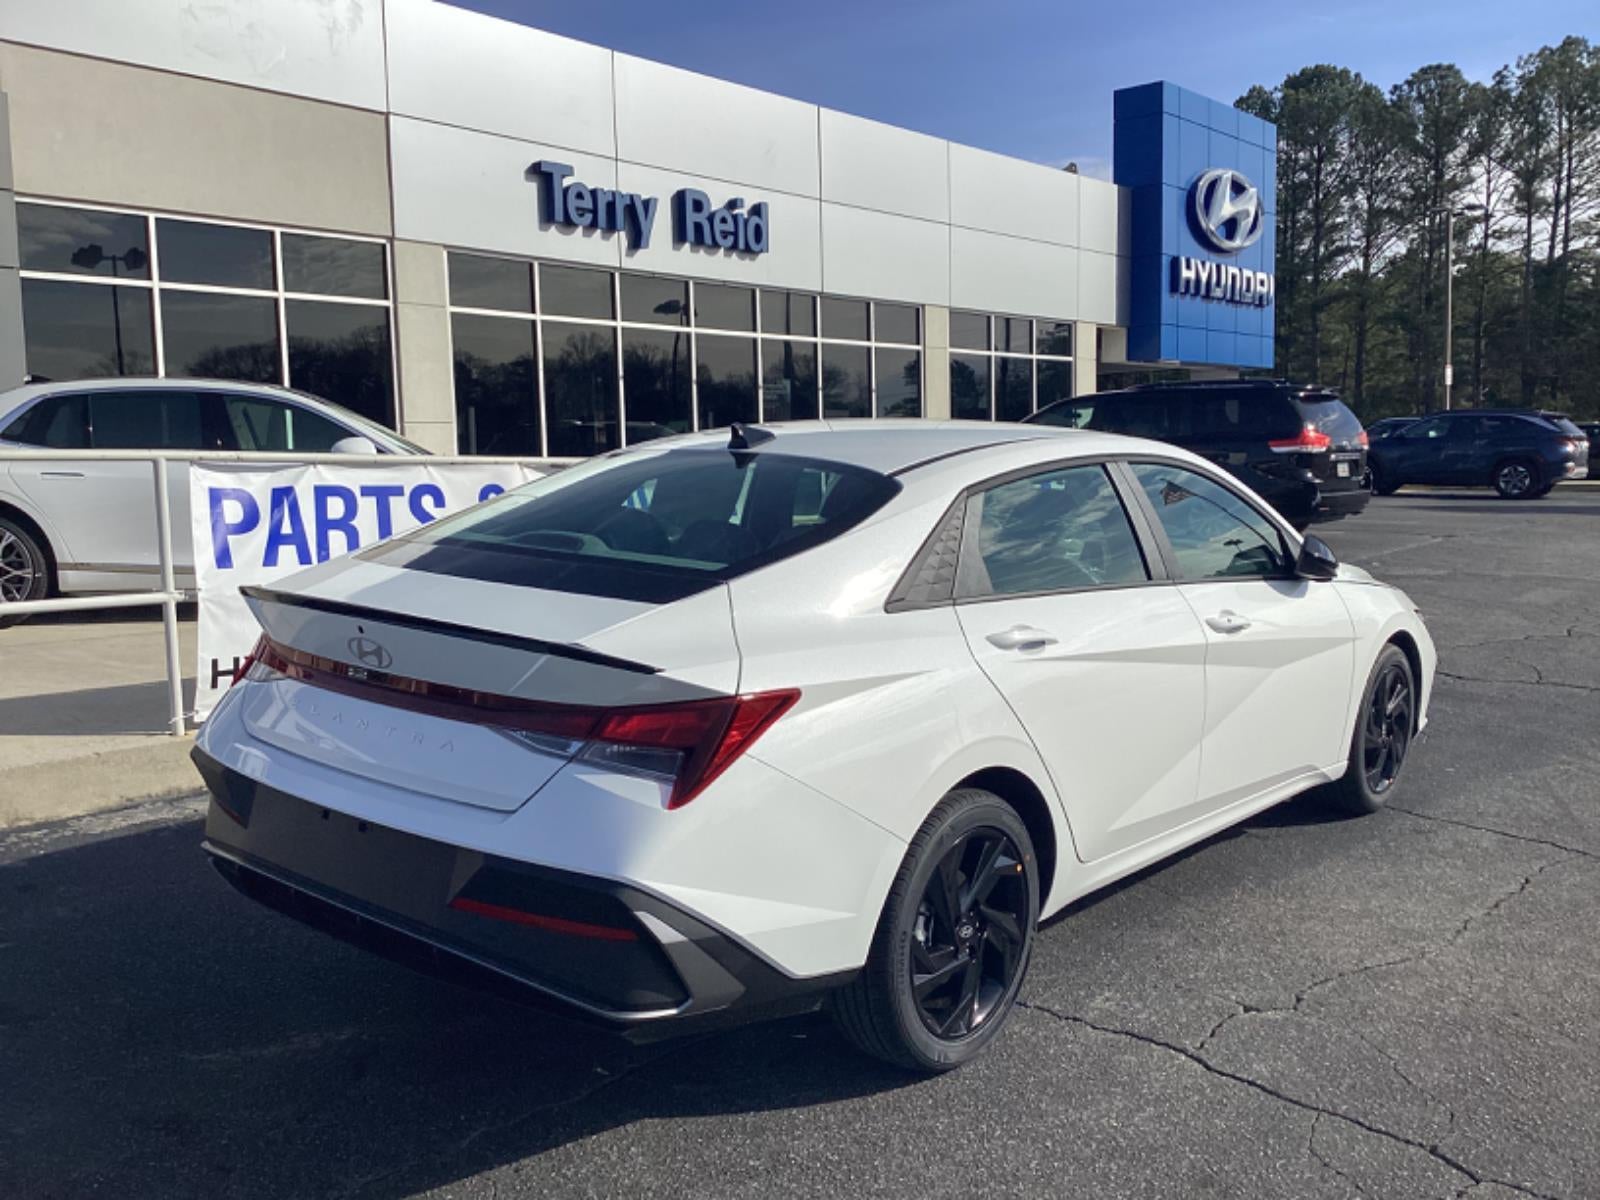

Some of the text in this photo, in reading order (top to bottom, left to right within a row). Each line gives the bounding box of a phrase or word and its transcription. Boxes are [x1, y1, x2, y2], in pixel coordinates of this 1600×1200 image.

[527, 160, 769, 254] Terry Reid
[1172, 256, 1275, 306] HYUNDAI
[287, 697, 455, 753] LANTRA
